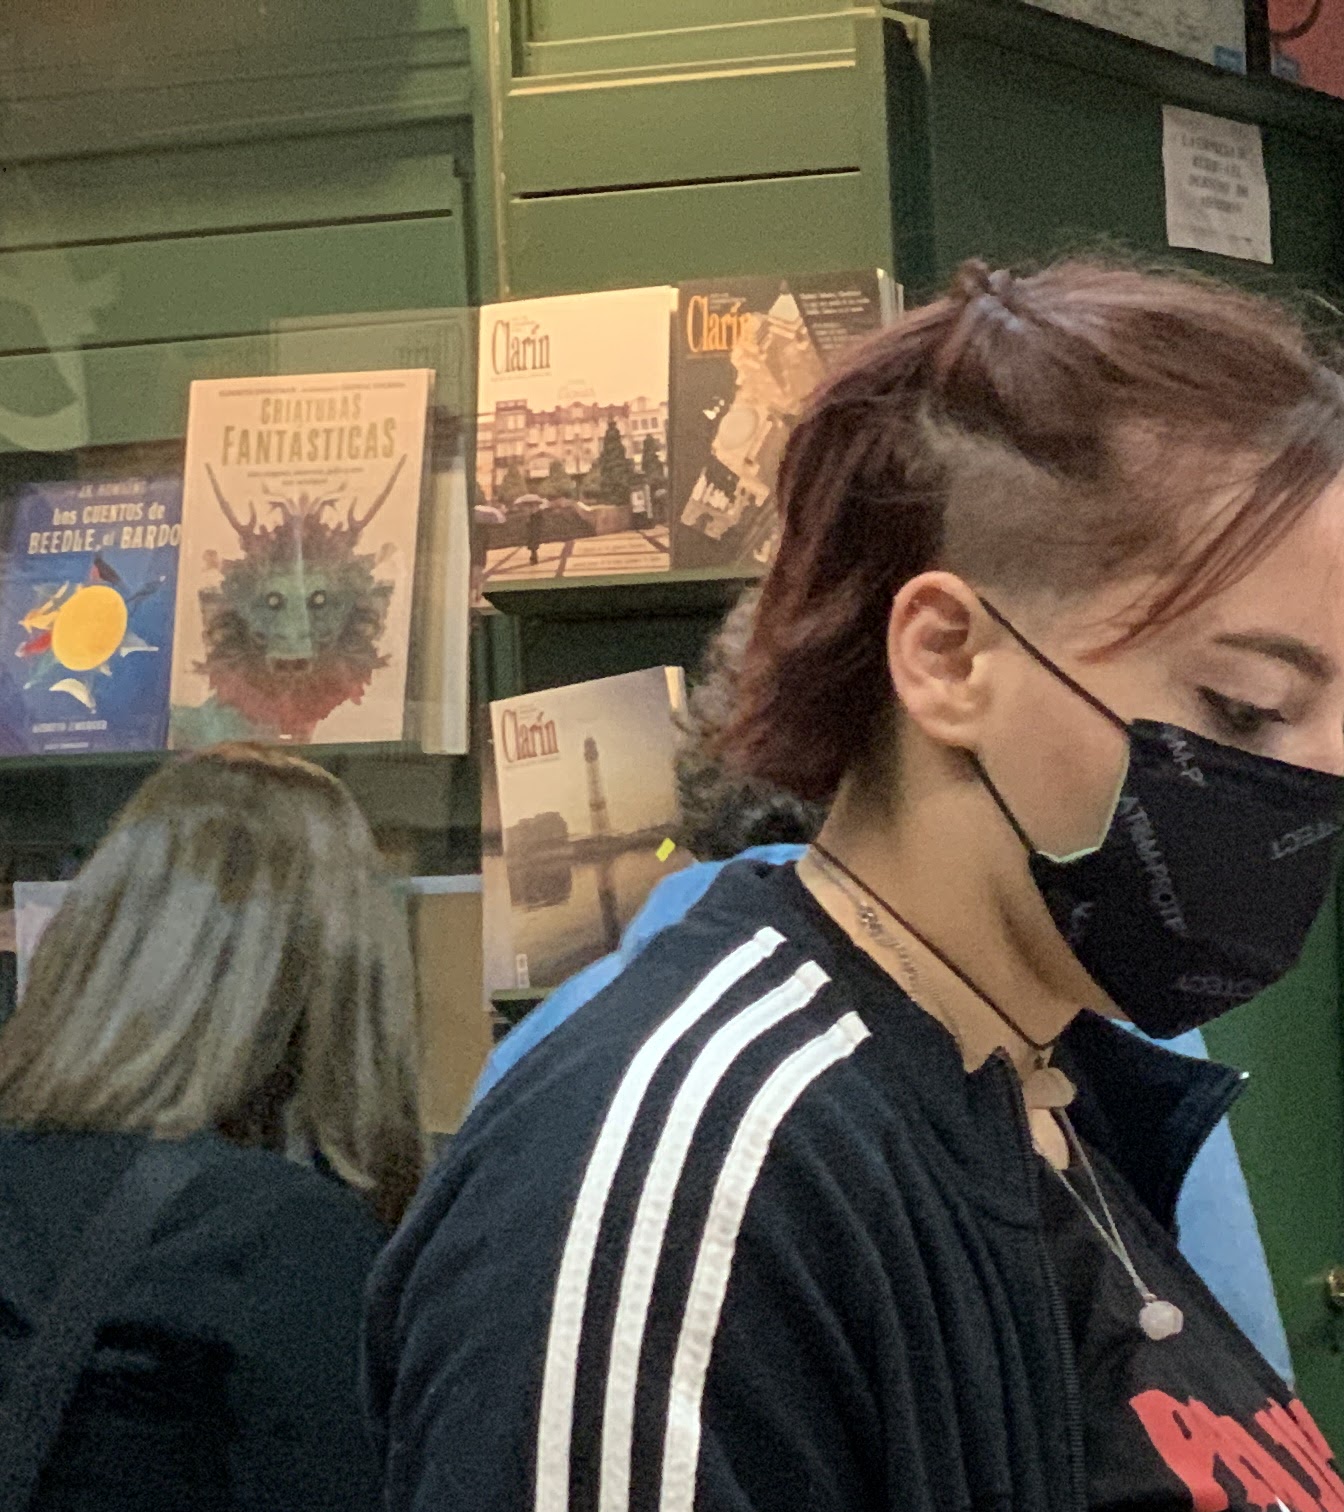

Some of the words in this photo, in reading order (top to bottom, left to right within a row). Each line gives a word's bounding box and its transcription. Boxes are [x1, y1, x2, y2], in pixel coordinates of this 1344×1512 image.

[491, 319, 551, 375] Clarín
[261, 393, 361, 426] CRIATURAS
[221, 417, 397, 467] FANTÁSTICAS
[82, 502, 144, 524] CUENTOS
[120, 523, 182, 550] BARDO
[501, 709, 560, 763] Clarín
